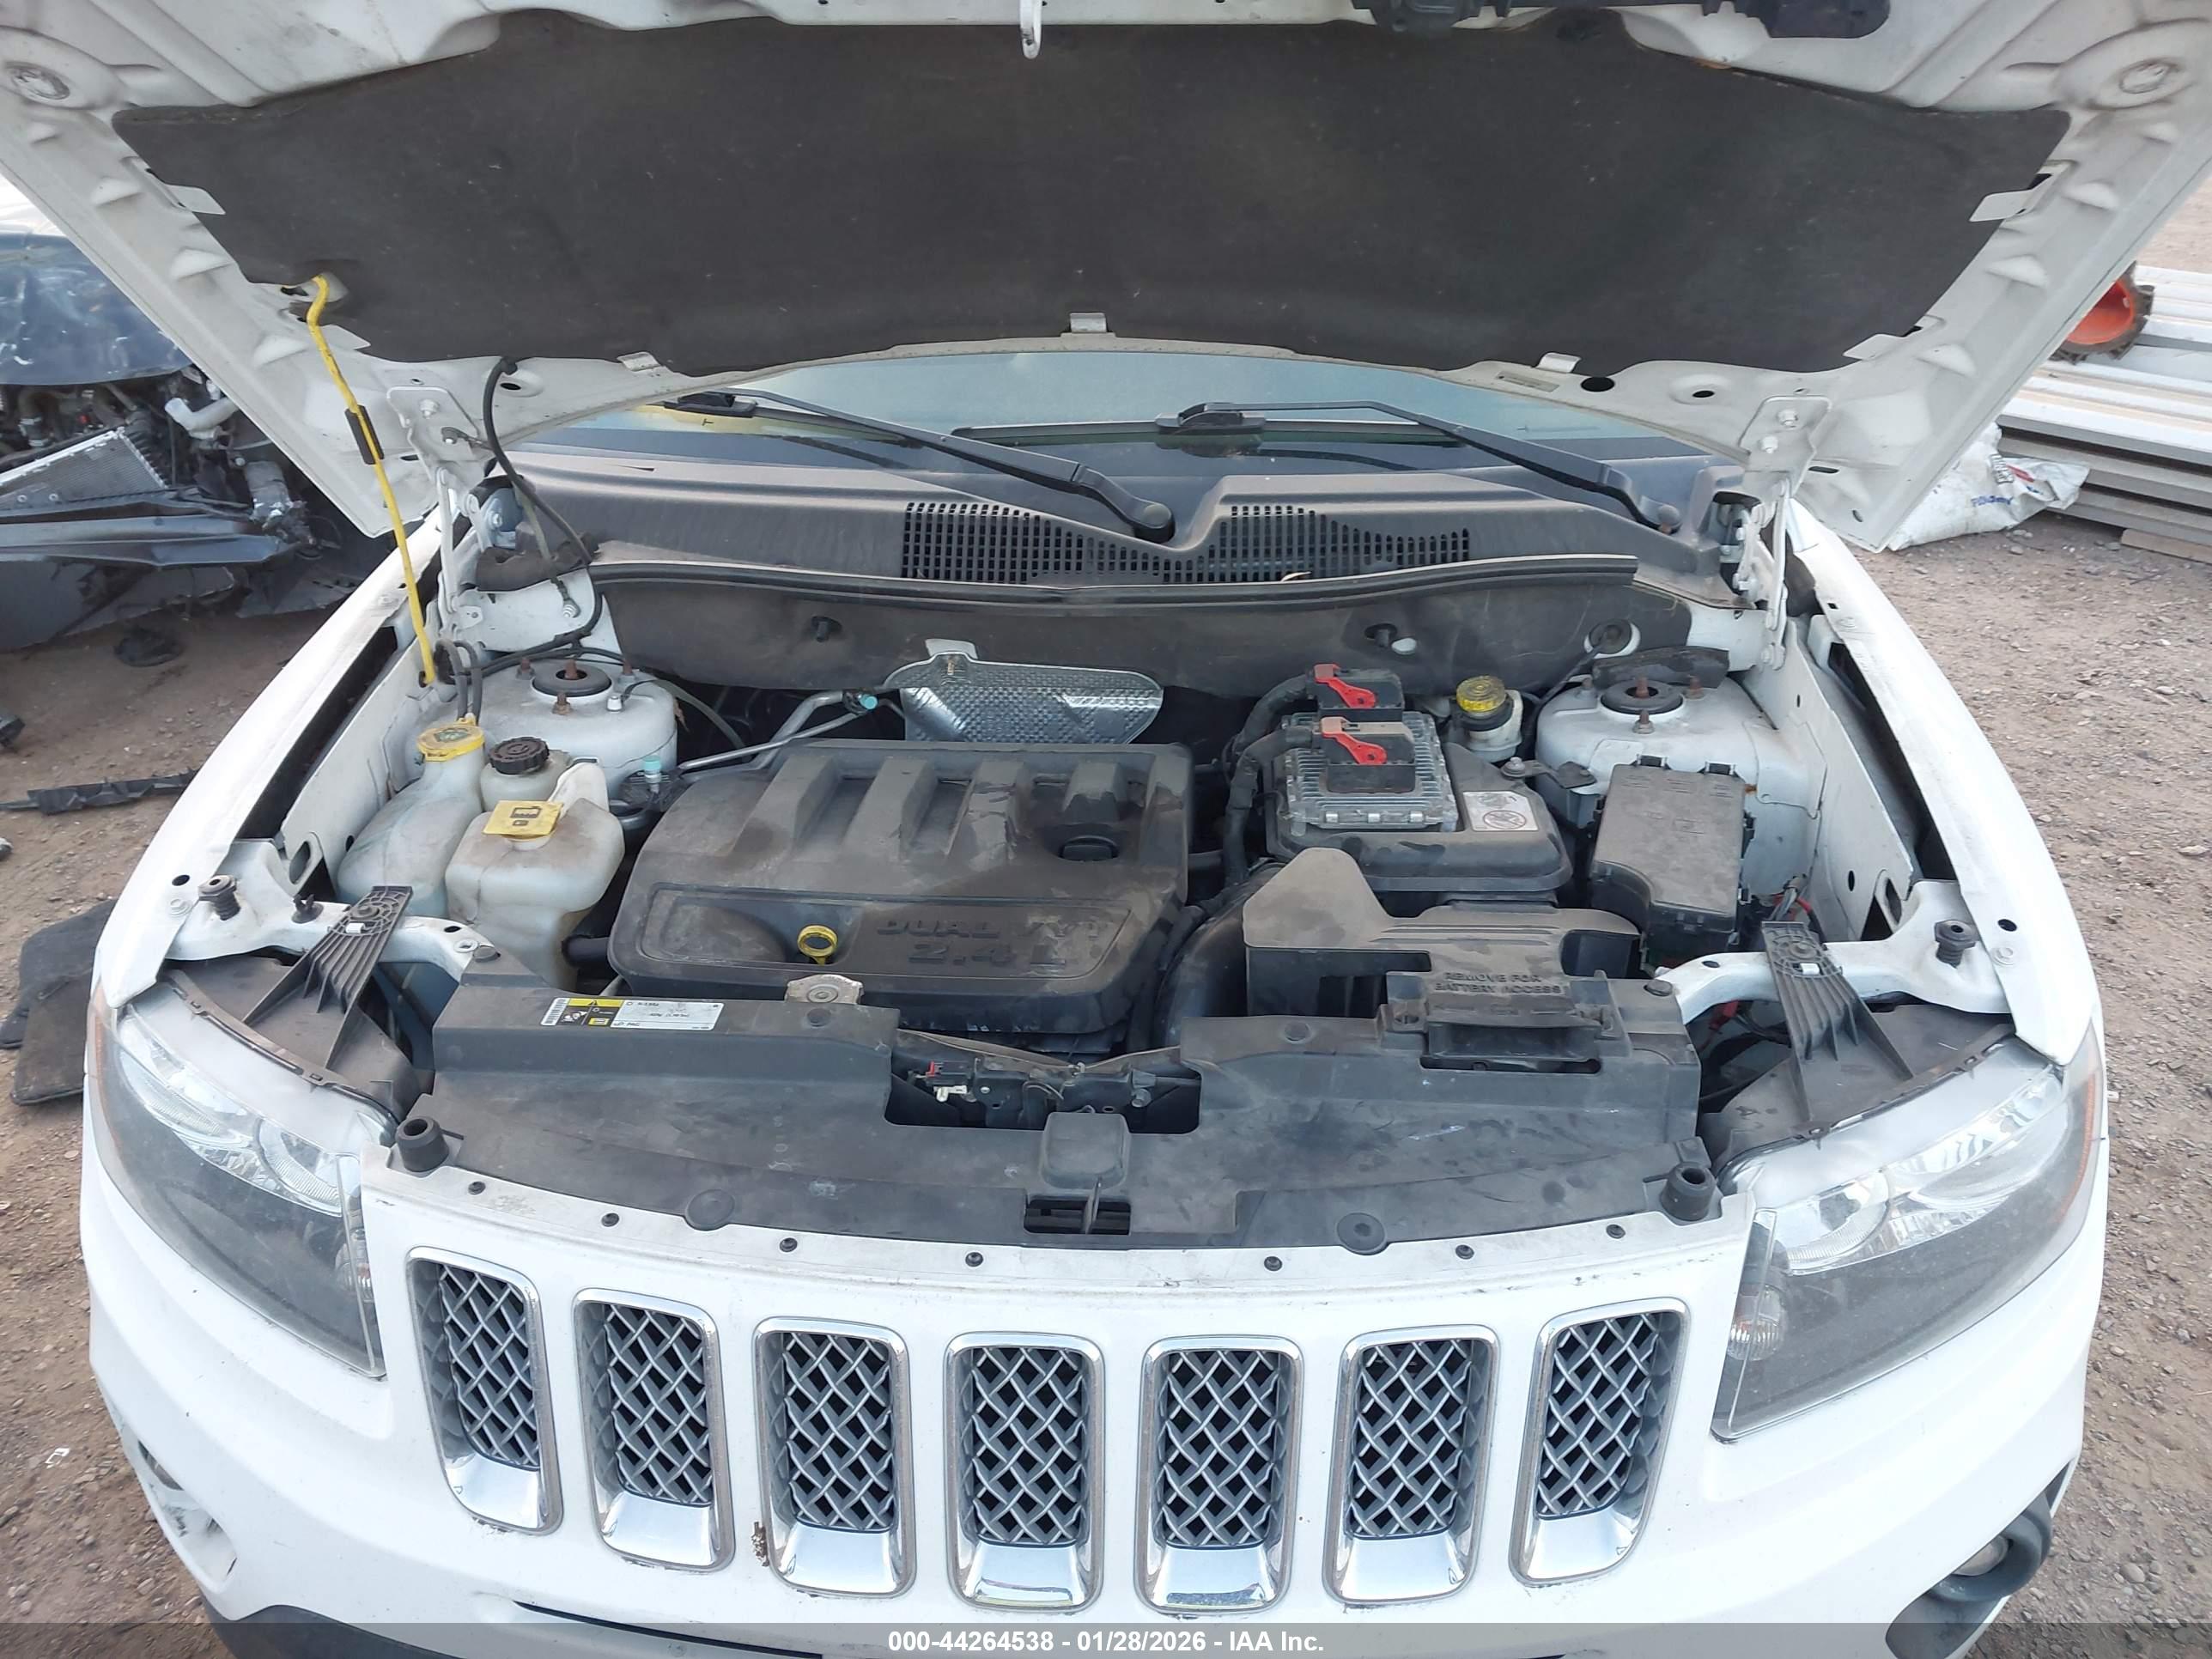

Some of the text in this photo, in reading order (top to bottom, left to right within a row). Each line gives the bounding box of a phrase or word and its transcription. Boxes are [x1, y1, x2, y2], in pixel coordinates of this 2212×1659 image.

[877, 919, 1000, 938] DUAL
[1444, 972, 1543, 984] REMOVE FOR
[1435, 982, 1563, 994] BATTERY ACCESS
